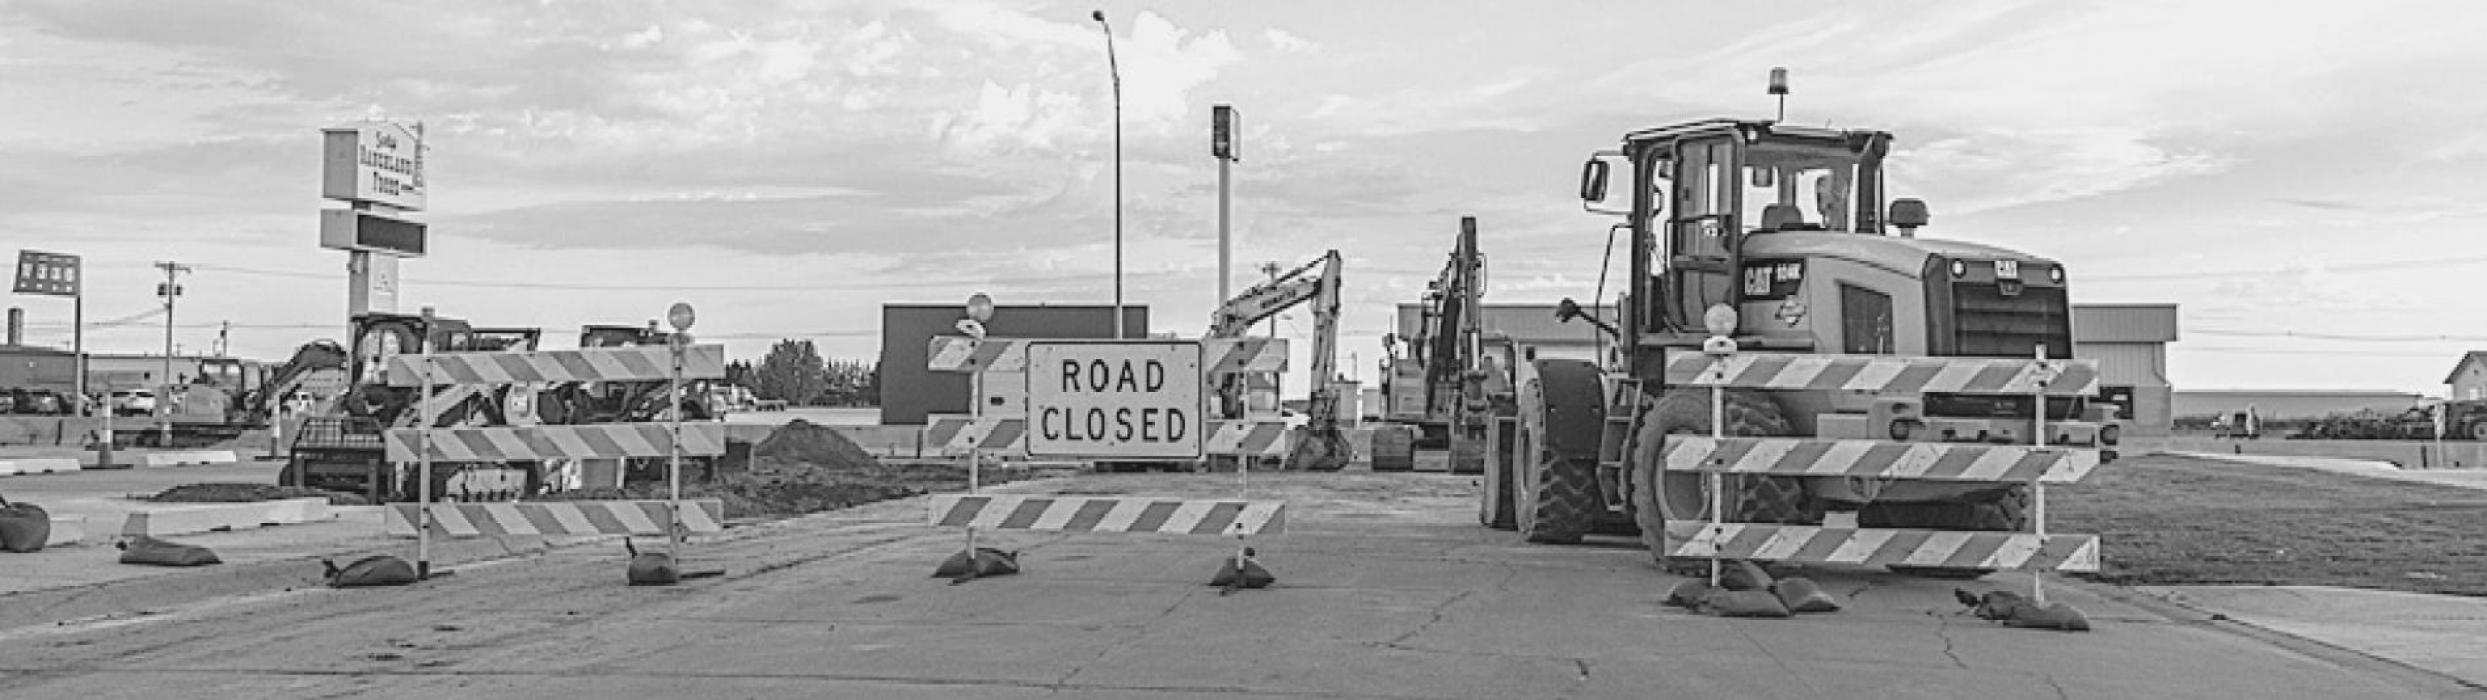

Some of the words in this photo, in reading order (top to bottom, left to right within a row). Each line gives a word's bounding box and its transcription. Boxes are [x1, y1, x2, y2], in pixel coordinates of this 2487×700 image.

[1745, 267, 1772, 294] CAT
[1062, 358, 1164, 392] ROAD
[1041, 407, 1186, 442] CLOSED
